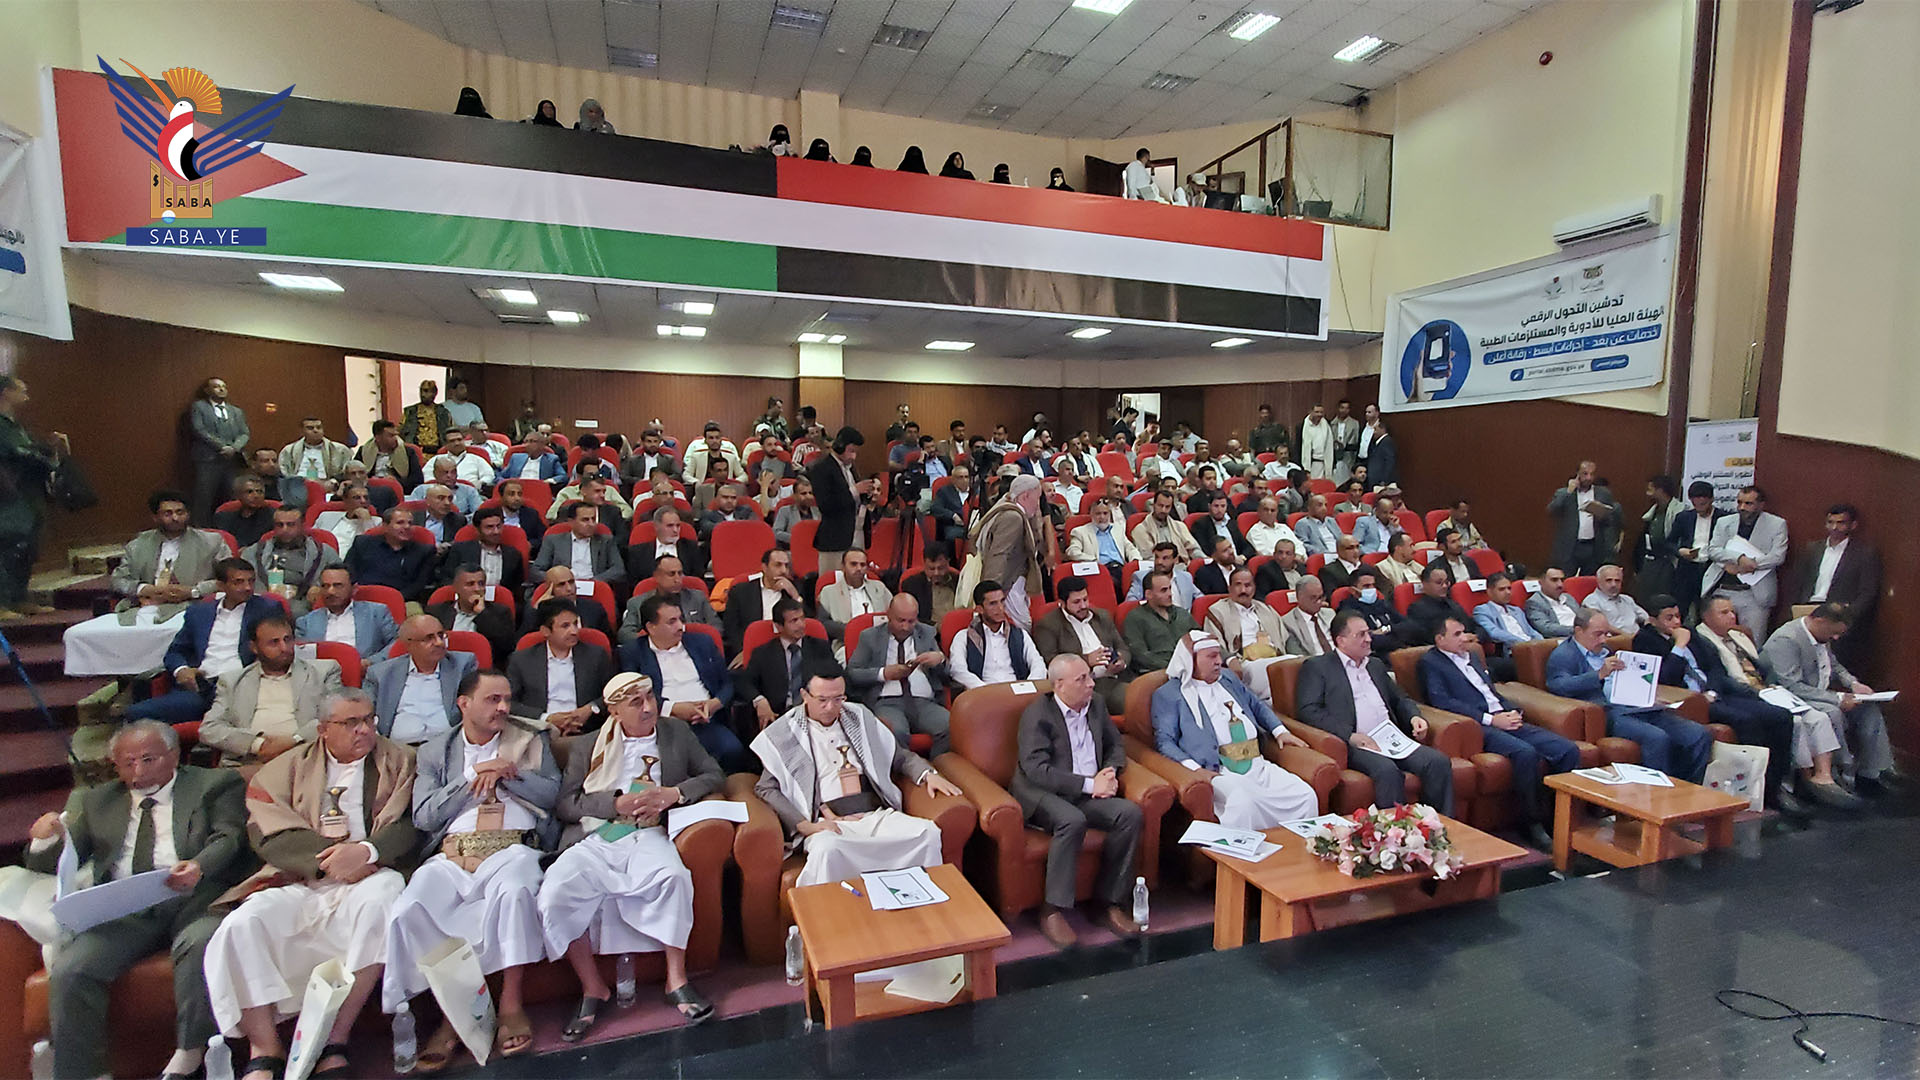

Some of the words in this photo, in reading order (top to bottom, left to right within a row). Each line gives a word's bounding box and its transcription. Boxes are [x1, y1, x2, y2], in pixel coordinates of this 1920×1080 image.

[1554, 302, 1588, 321] التحول
[1589, 294, 1624, 313] تدشين
[1521, 309, 1554, 328] الرقمي
[1568, 315, 1604, 335] للأدوية
[1607, 311, 1635, 328] العليا
[1480, 334, 1507, 349] الطبية
[1507, 325, 1567, 343] والمستلزمات
[1591, 336, 1609, 348] بعد
[1610, 334, 1626, 346] عن
[1626, 327, 1658, 341] خدمات
